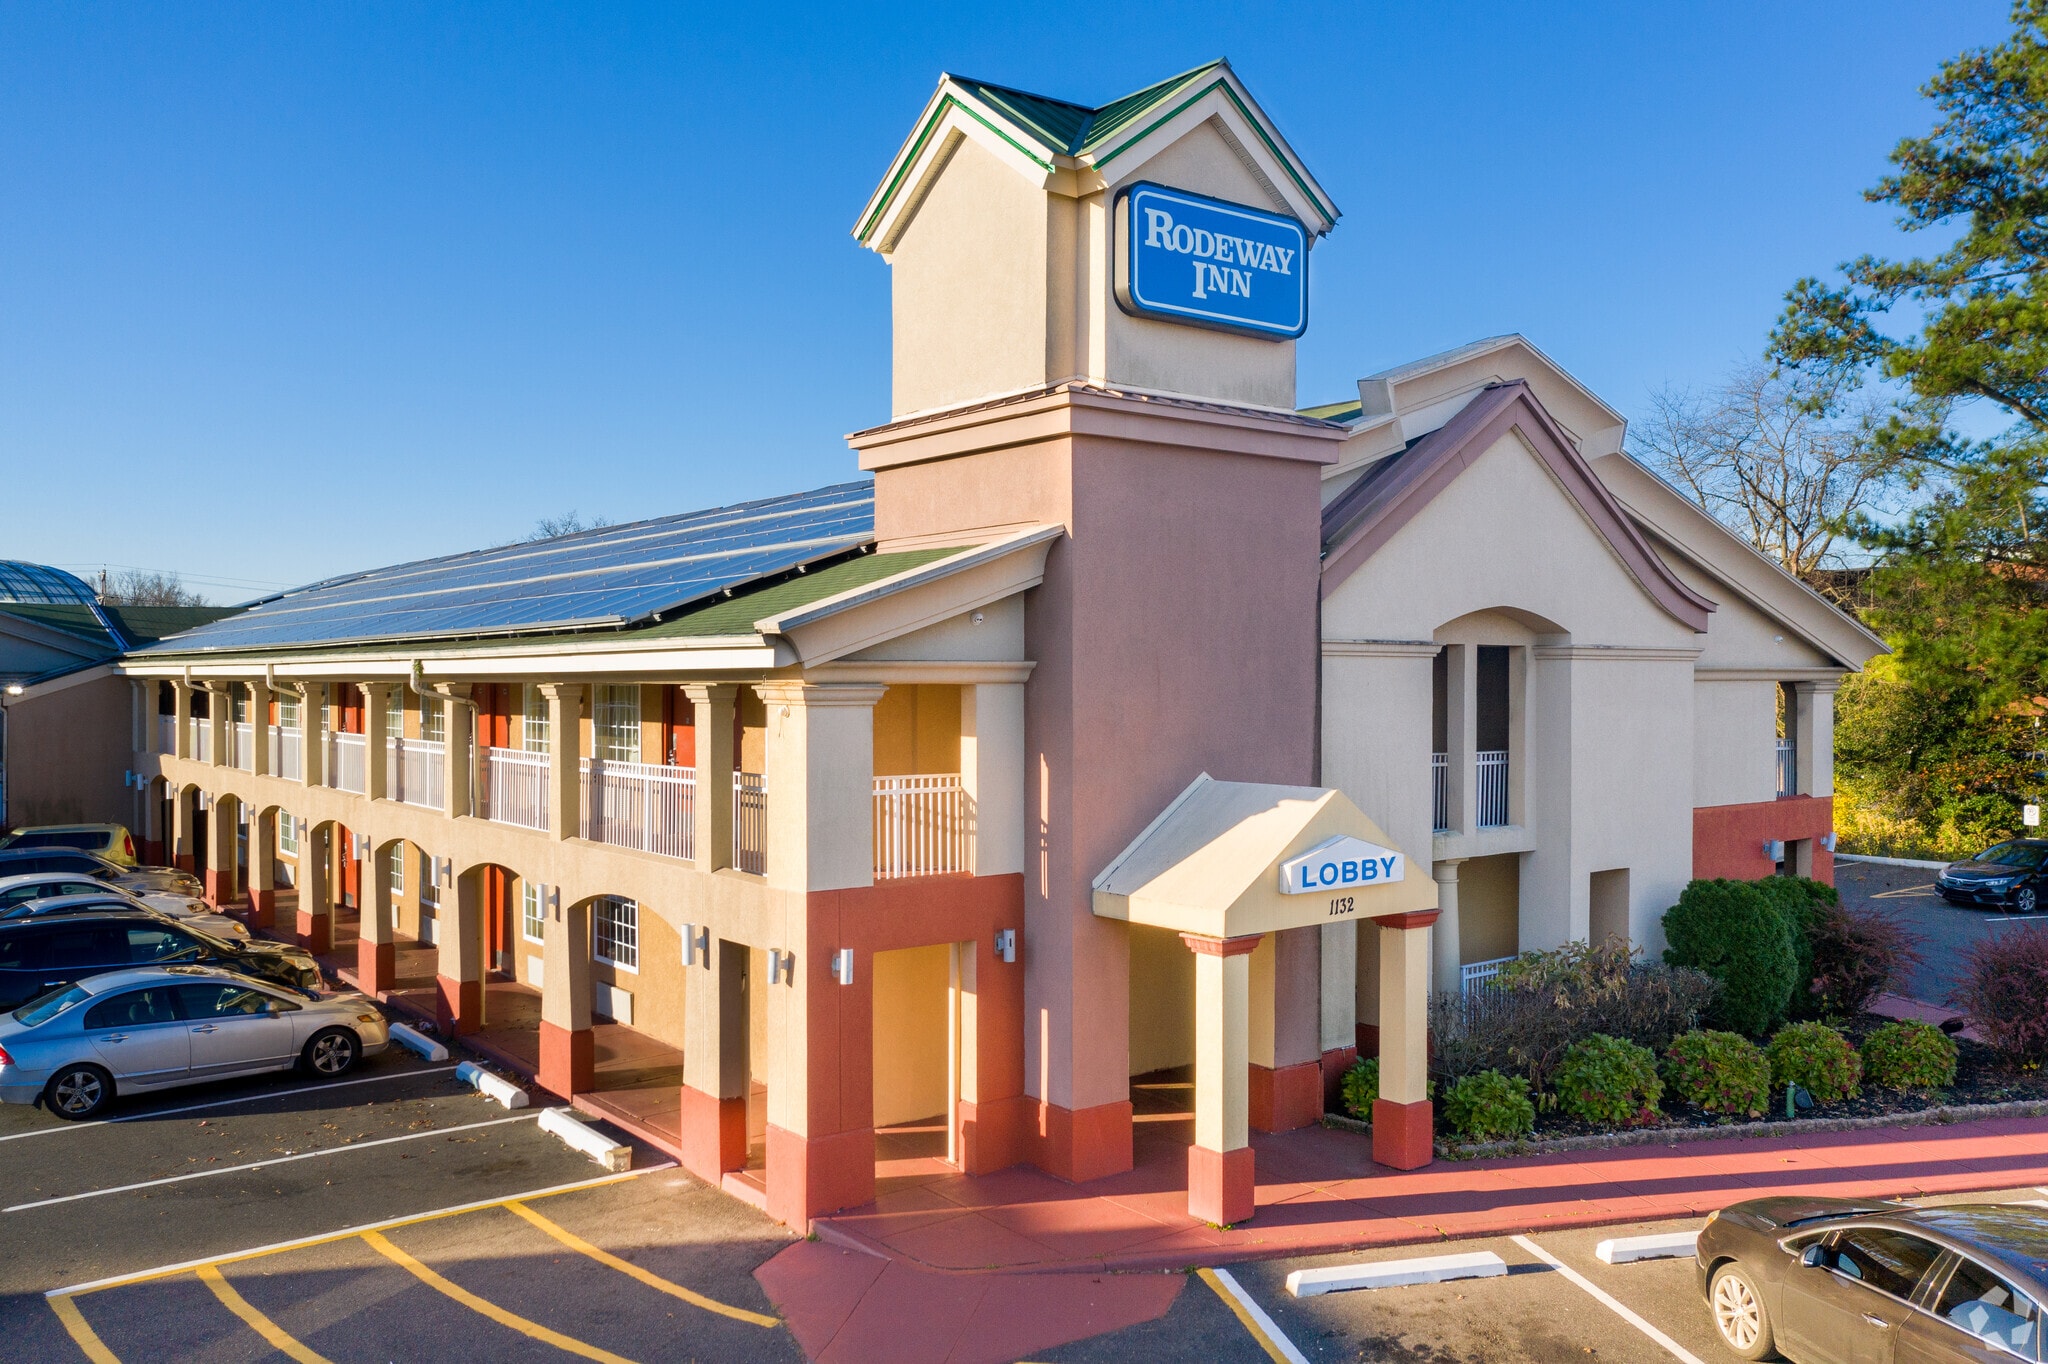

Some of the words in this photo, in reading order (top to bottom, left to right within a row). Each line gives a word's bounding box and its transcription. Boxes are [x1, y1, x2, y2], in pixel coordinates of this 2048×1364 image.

[1144, 207, 1295, 275] RODEWAY
[1192, 261, 1252, 299] INN
[1302, 856, 1396, 888] LOBBY
[1329, 897, 1354, 916] 1132
